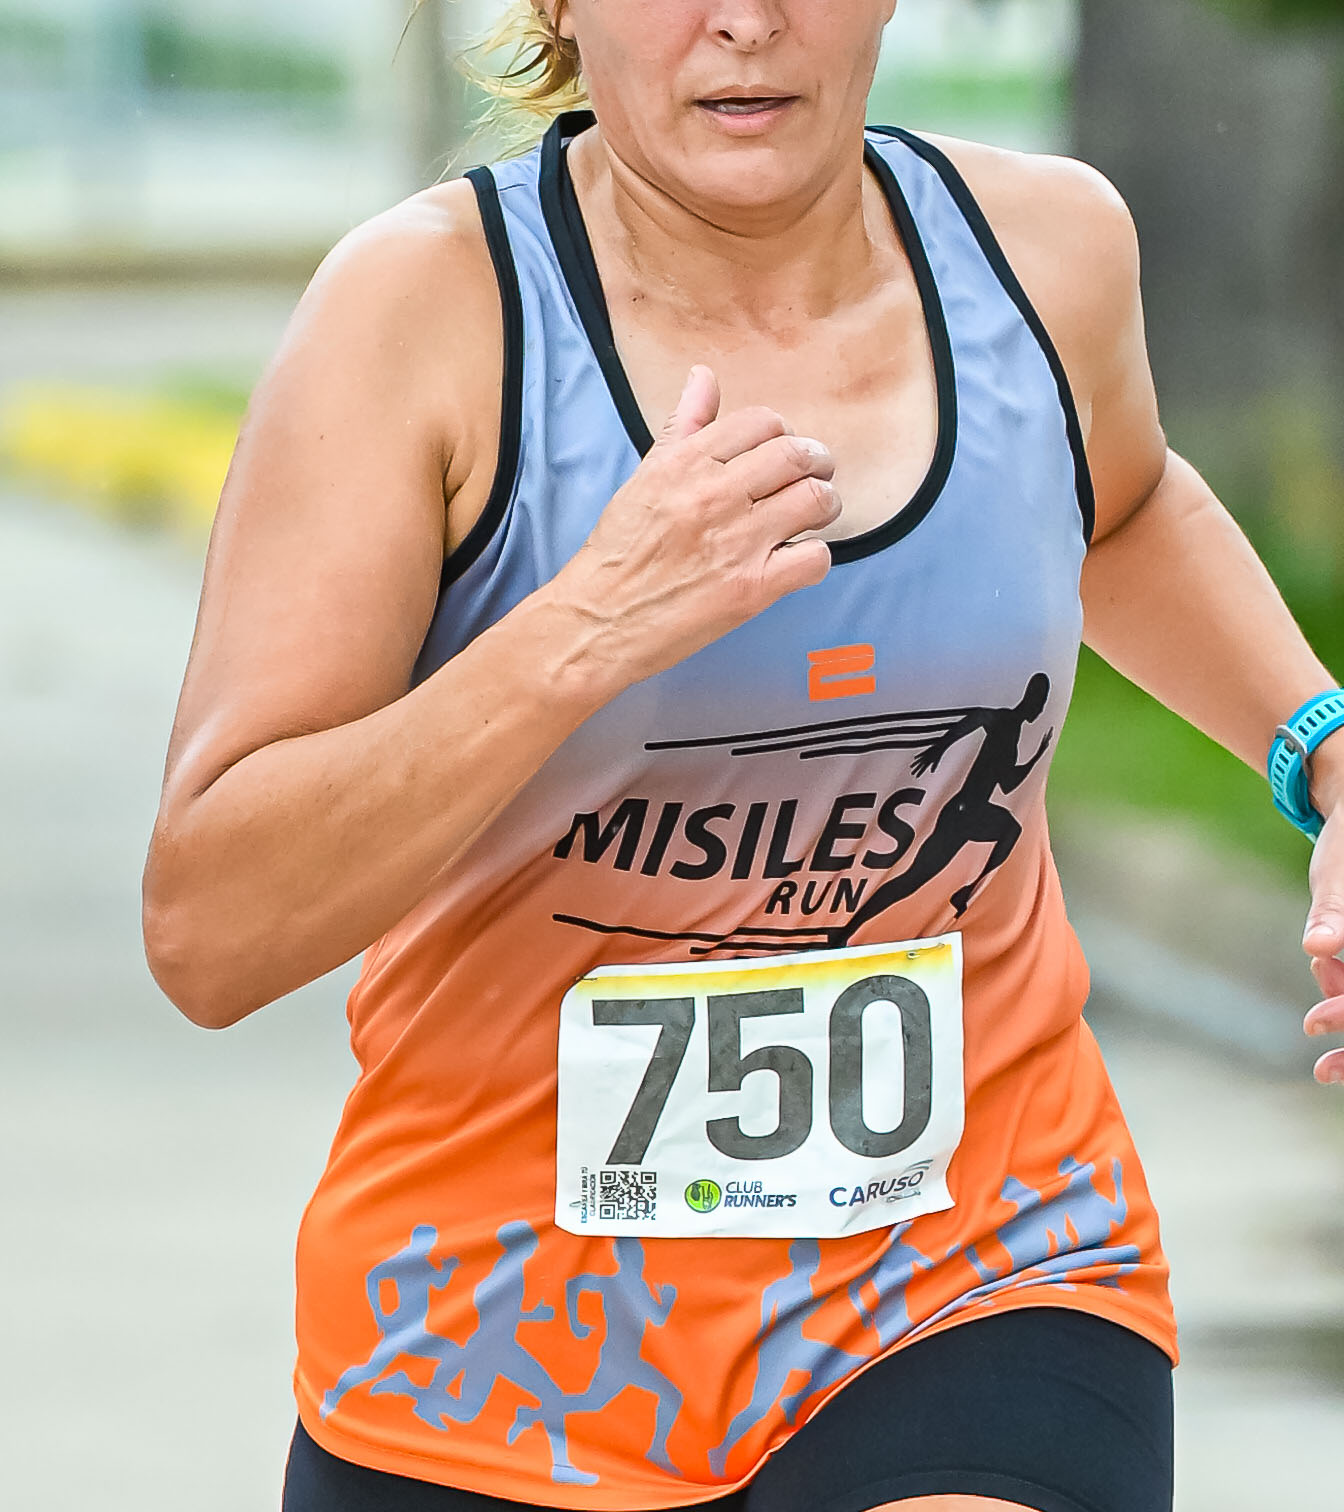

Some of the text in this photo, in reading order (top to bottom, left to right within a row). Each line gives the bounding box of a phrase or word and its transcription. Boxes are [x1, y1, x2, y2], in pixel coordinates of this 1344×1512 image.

[553, 787, 927, 881] MISILES
[764, 877, 869, 916] RUN
[591, 974, 933, 1166] 750
[724, 1194, 796, 1208] RUNNER'S
[725, 1180, 763, 1194] CLUB
[829, 1171, 924, 1207] CARUSO
